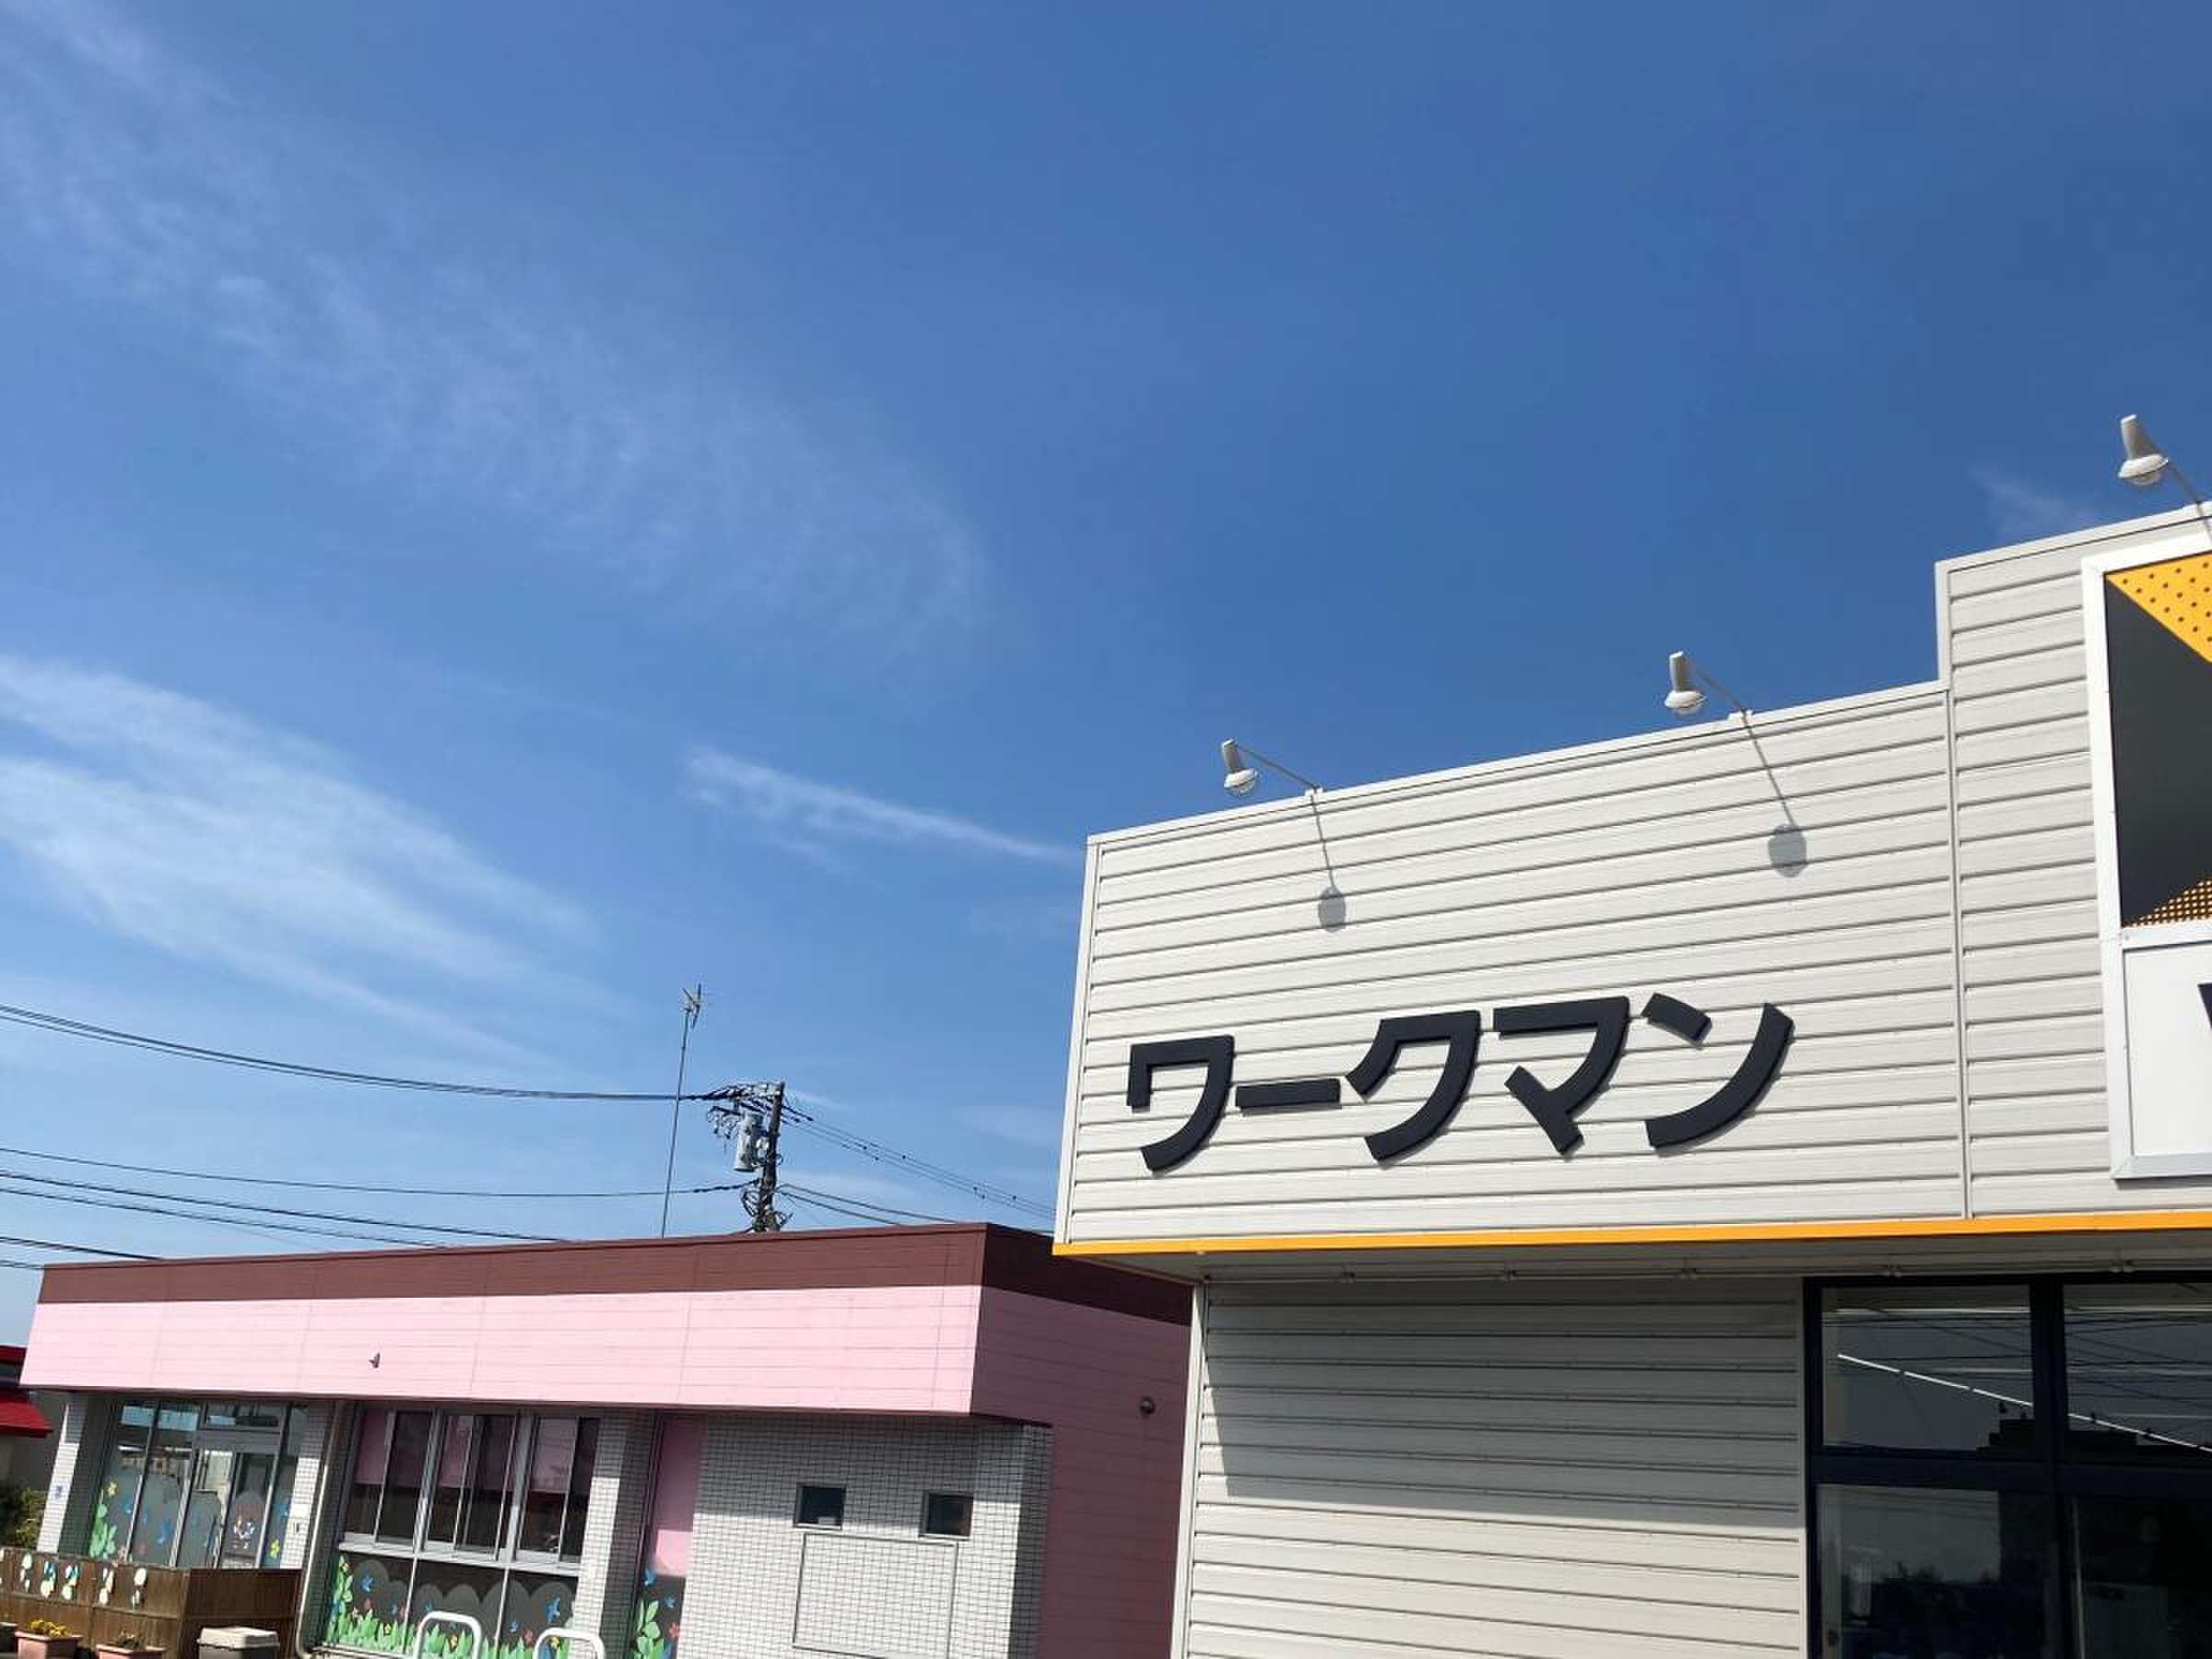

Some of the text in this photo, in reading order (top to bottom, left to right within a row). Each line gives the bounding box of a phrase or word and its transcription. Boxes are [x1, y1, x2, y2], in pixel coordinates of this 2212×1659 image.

[1126, 993, 1795, 1172] ワークマン
